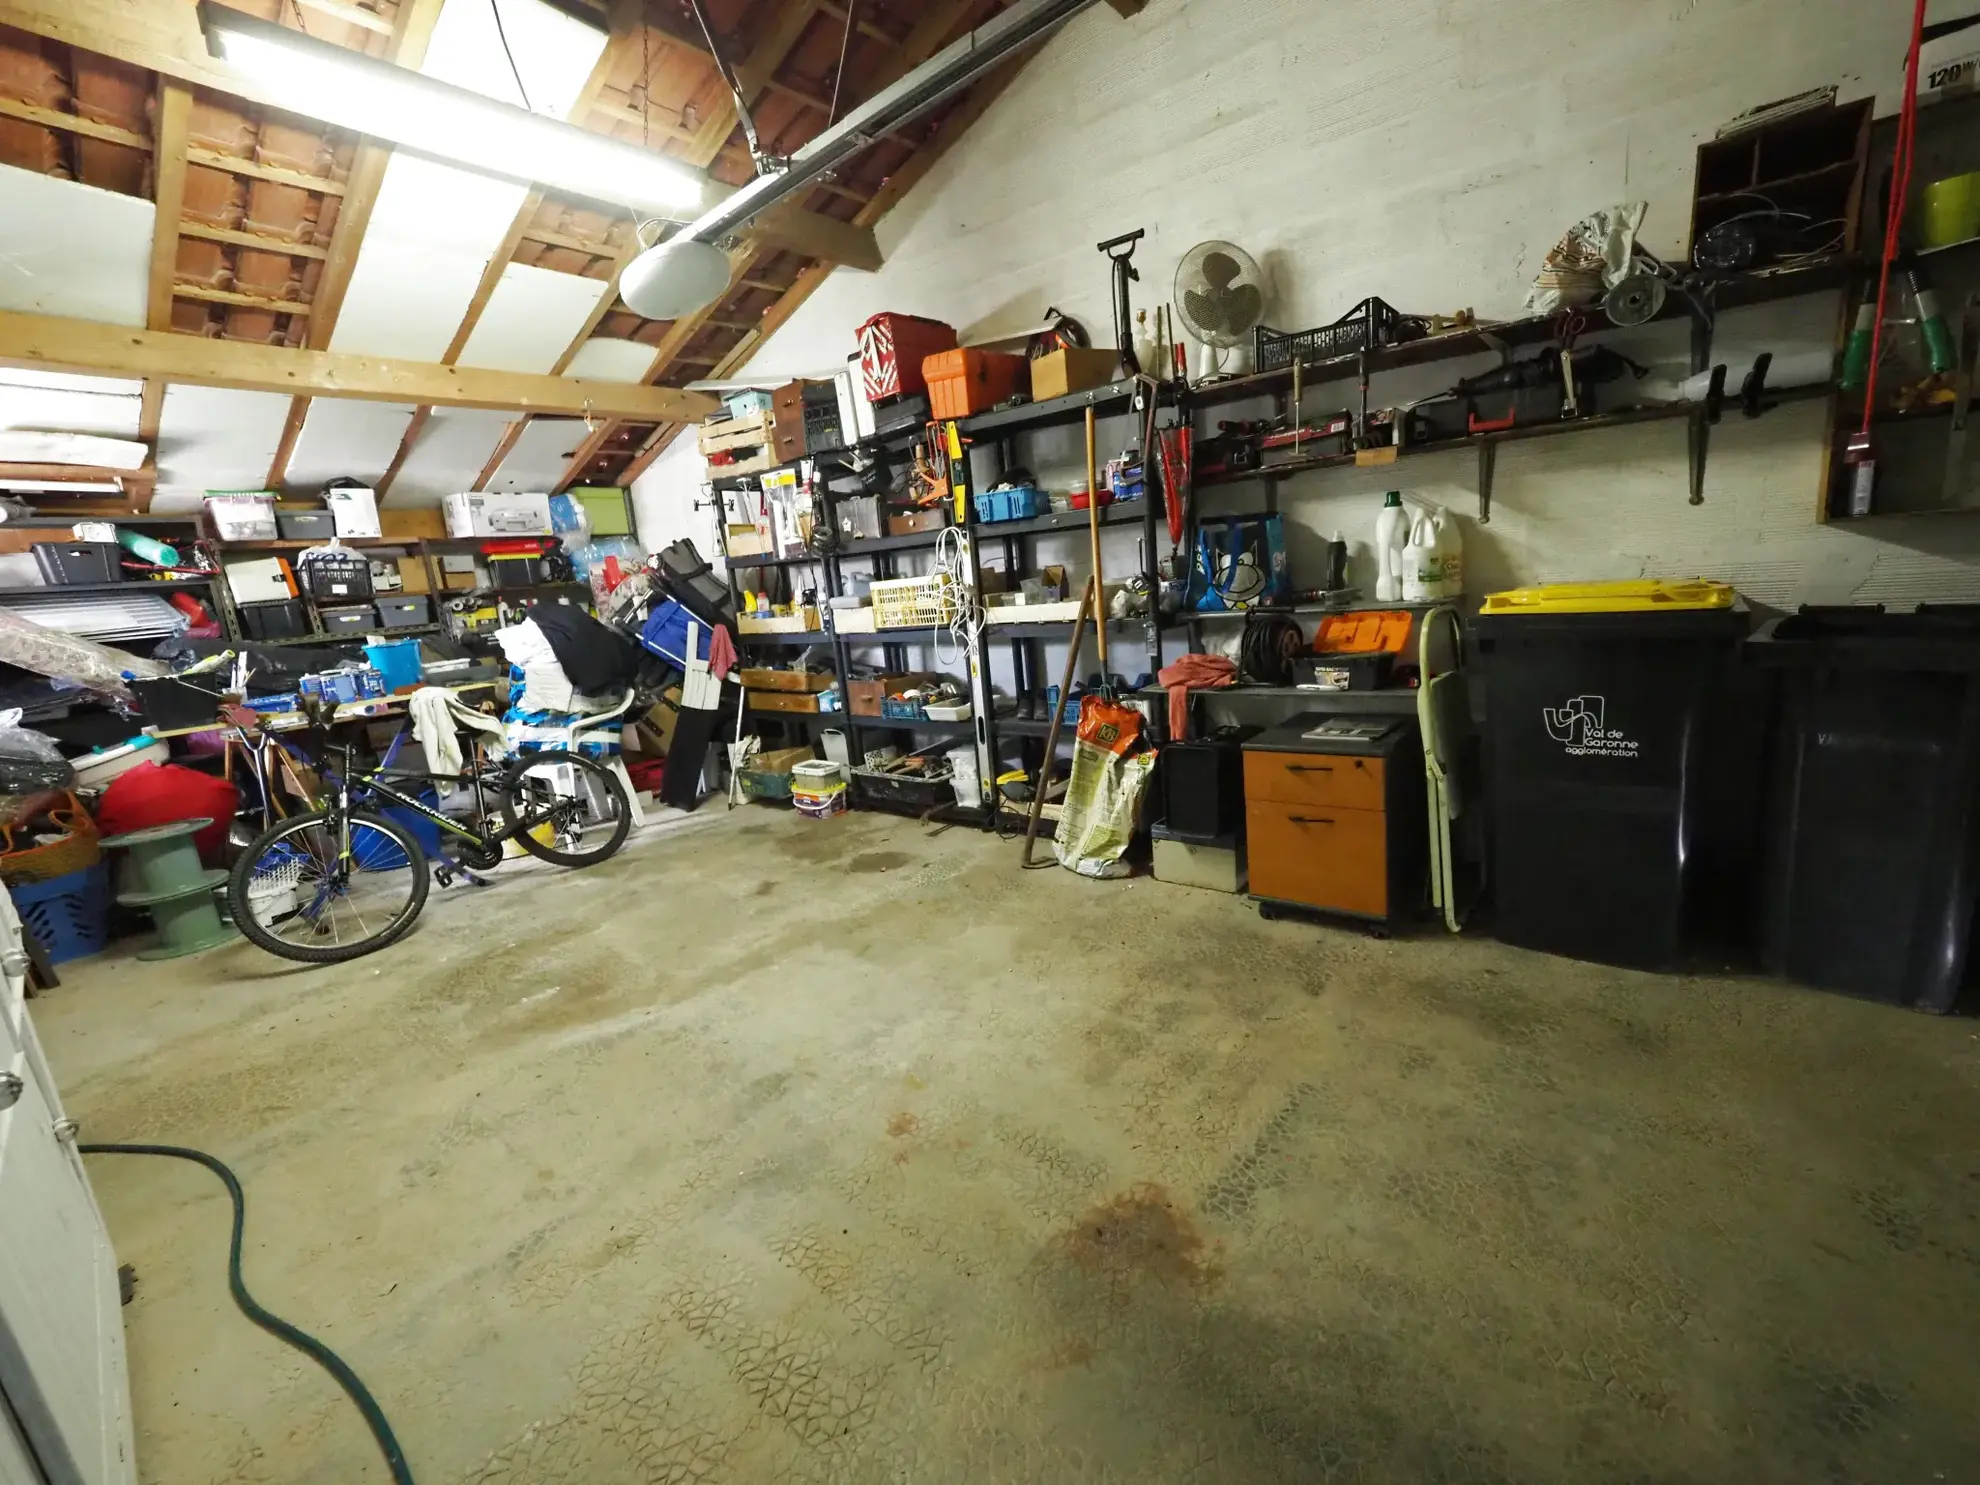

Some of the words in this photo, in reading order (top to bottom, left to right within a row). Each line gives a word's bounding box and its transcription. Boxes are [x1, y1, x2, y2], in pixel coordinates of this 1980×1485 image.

[1928, 65, 1962, 89] 120
[1585, 728, 1605, 738] Val
[1607, 729, 1624, 739] de
[1584, 737, 1639, 749] Garonne
[1565, 746, 1638, 758] agglomération
[396, 792, 468, 831] ROCKRIDER
